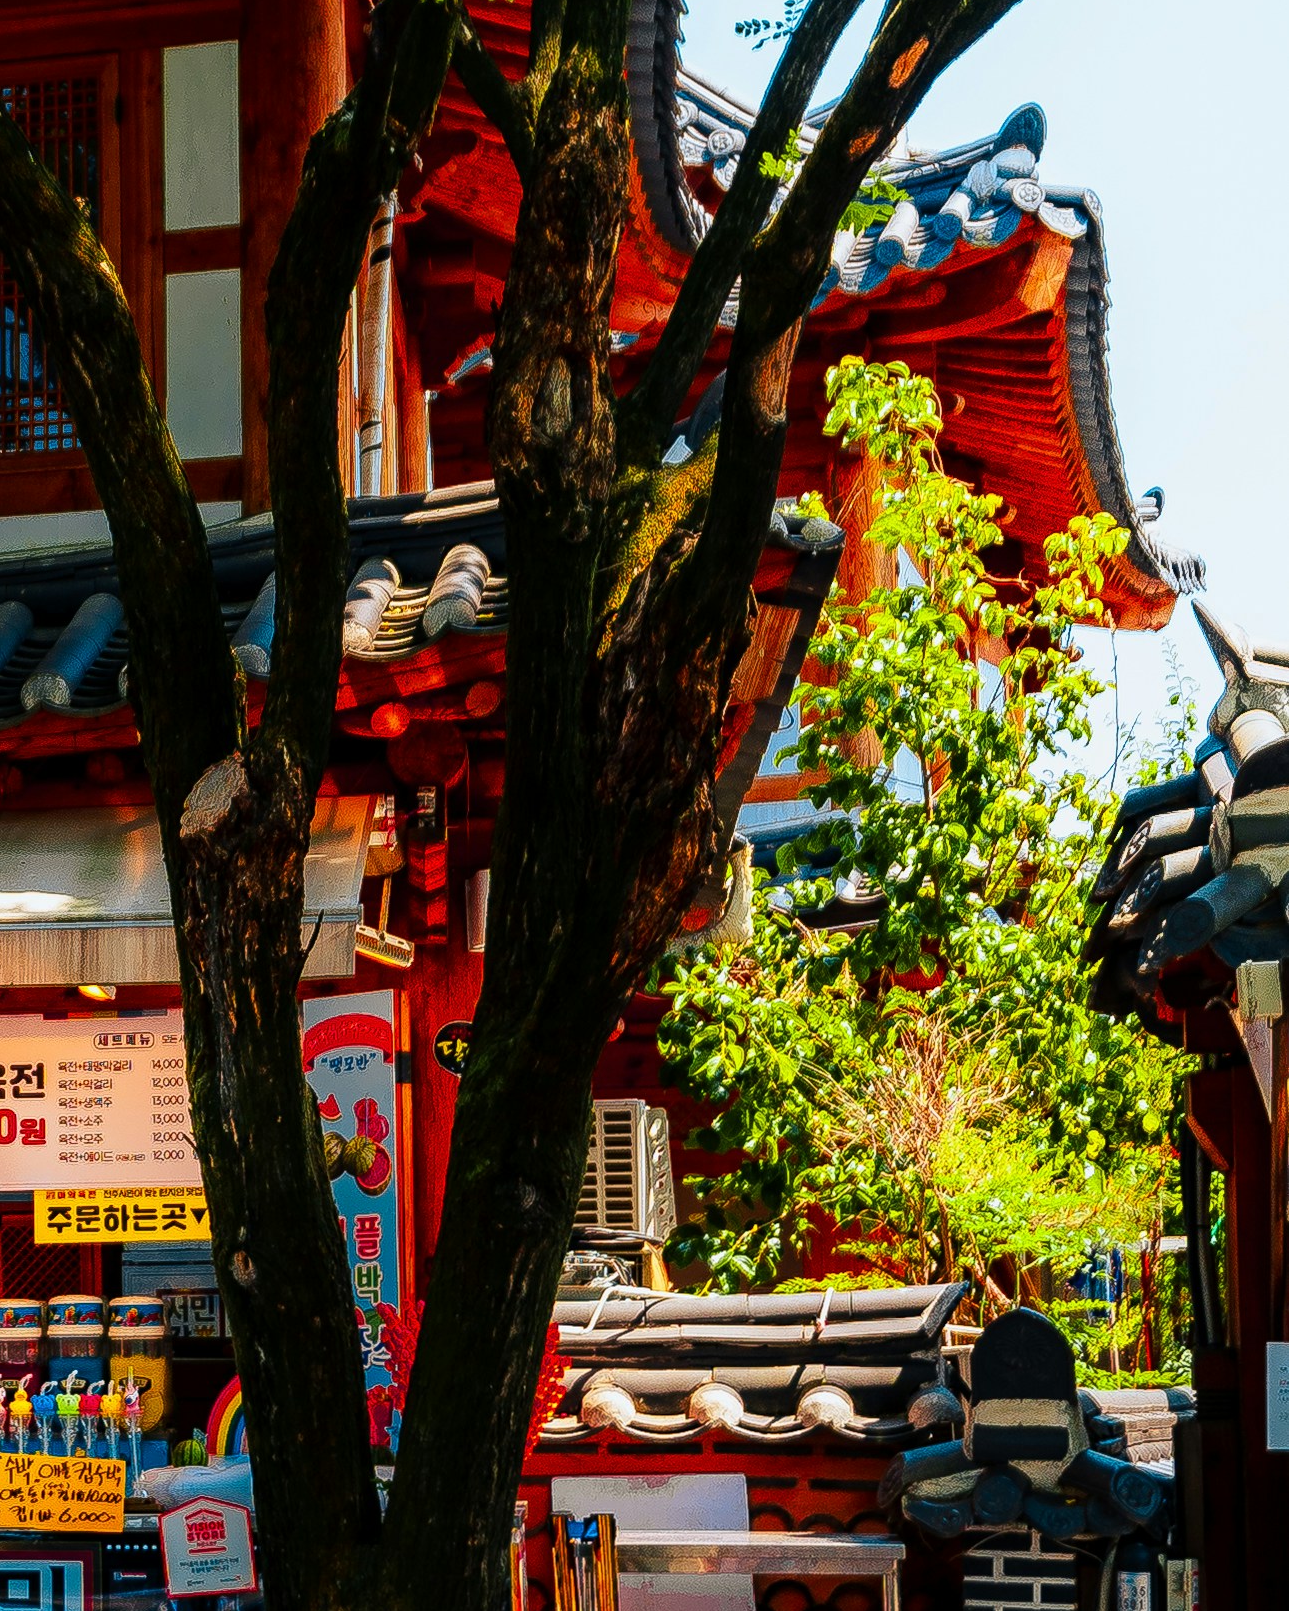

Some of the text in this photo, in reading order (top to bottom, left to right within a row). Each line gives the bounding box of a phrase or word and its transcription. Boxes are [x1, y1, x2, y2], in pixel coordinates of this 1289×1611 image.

[151, 1058, 184, 1070] 14,000
[151, 1077, 184, 1089] 12,000
[151, 1095, 185, 1108] 13,000
[151, 1113, 185, 1126] 13,000
[152, 1131, 184, 1144] 12,000
[152, 1150, 185, 1162] 12,000
[47, 1203, 187, 1233] 주문하는곳
[186, 1520, 224, 1532] VISION
[186, 1530, 226, 1542] STORE
